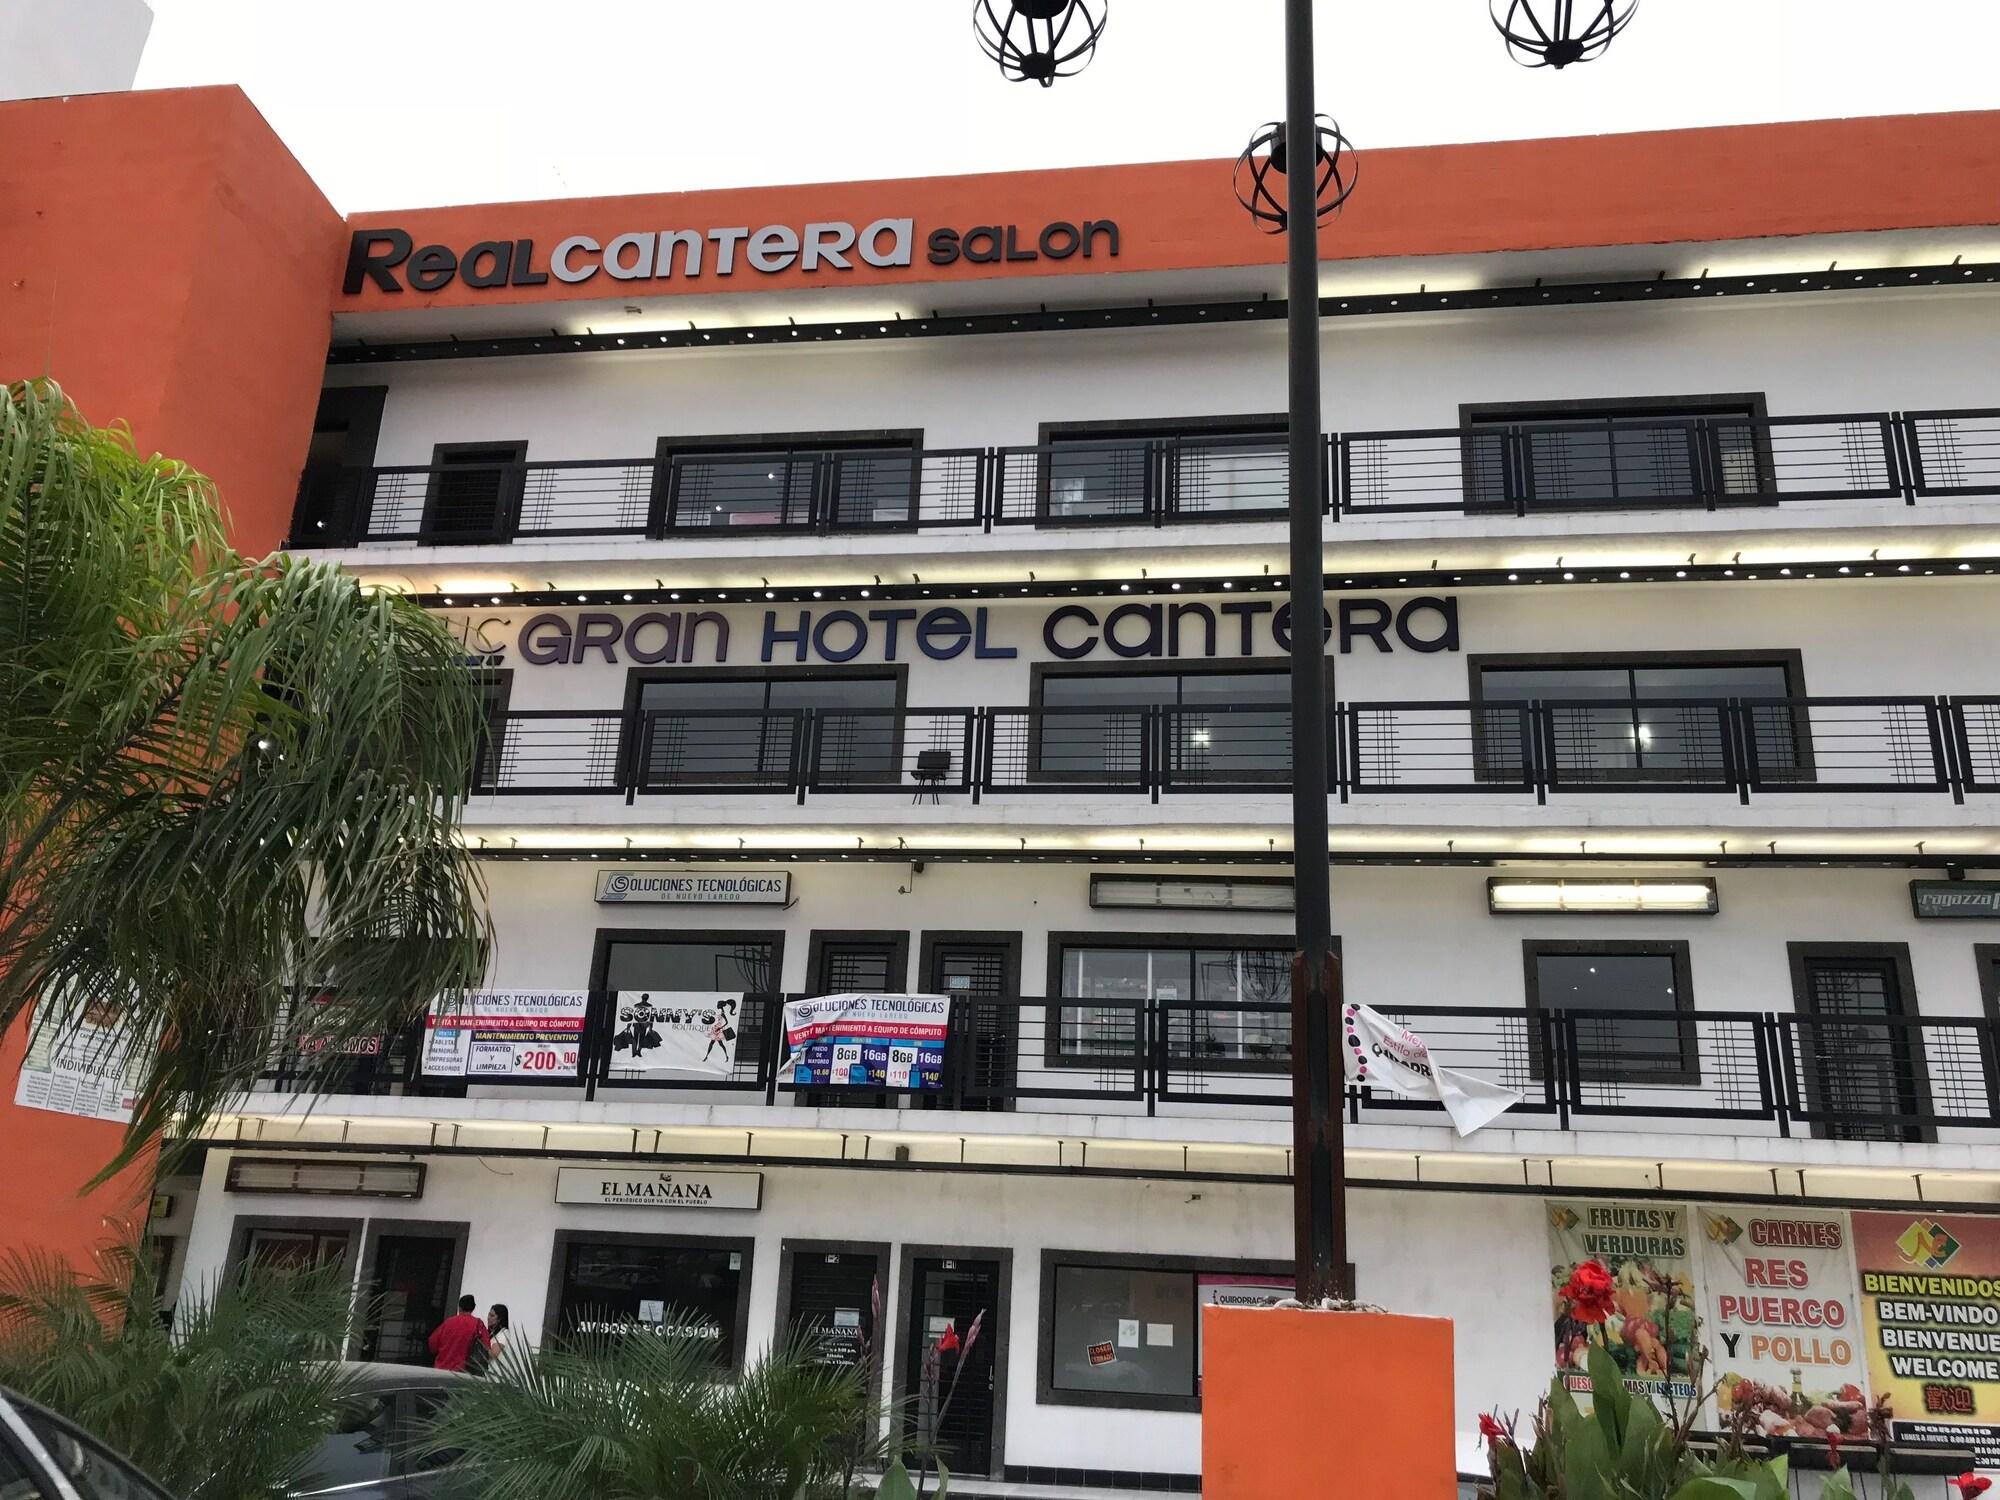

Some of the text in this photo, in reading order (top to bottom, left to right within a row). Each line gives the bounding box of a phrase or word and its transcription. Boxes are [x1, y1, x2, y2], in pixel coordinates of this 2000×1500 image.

[697, 877, 781, 892] TECNOLÓGICAS
[513, 993, 583, 1006] TECNOLÓGICAS
[871, 999, 944, 1013] TECNOLÓGICAS
[509, 1019, 514, 1027] A
[540, 1020, 548, 1028] DE
[549, 1019, 579, 1028] CÓMPUTO
[475, 1032, 579, 1041] MANTENIMIENTO PREVENTIVO
[874, 1026, 898, 1034] EQUIPO
[900, 1027, 908, 1035] DE
[910, 1027, 942, 1036] CÓMPUTO
[837, 1047, 857, 1060] 8GB
[864, 1049, 887, 1061] 16GB
[892, 1049, 913, 1063] 8GB
[919, 1053, 942, 1064] 16GB
[475, 1063, 507, 1071] LIMPIEZA
[601, 1182, 621, 1195] EL
[1589, 1207, 1678, 1230] FRUTAS Y
[1749, 1219, 1843, 1249] CARNES
[1584, 1233, 1686, 1257] VERDURAS
[1745, 1258, 1809, 1288] RES
[1864, 1274, 2000, 1298] BIENVENIDOS
[1719, 1295, 1846, 1328] PUERCO
[1879, 1301, 1998, 1325] BEM-VINDO
[1882, 1328, 2000, 1352] BIENVENUE
[1720, 1333, 1853, 1367] Y POLLO
[1891, 1356, 2000, 1380] WELCOME
[1914, 1425, 1992, 1435] HORARIO
